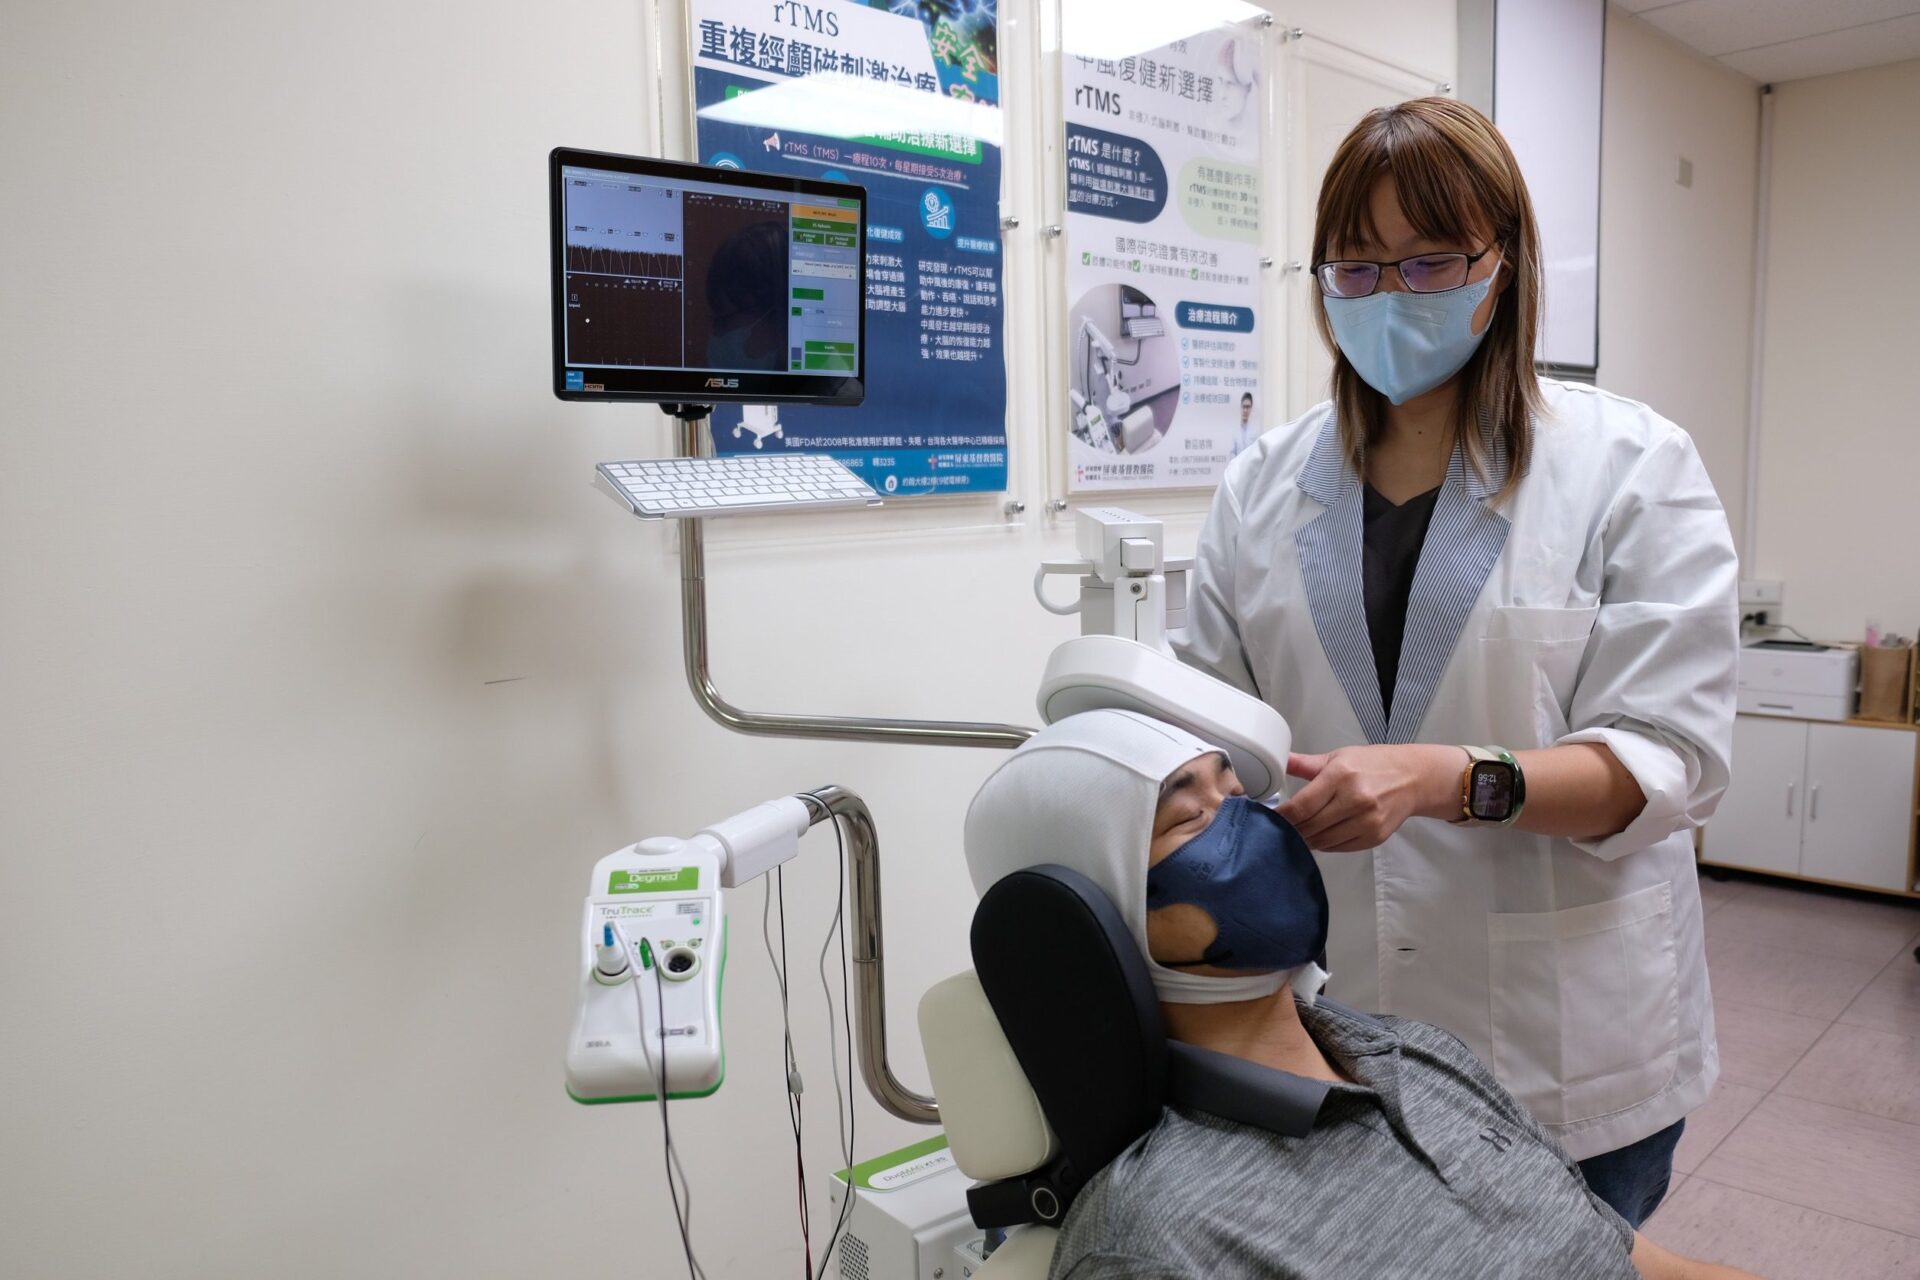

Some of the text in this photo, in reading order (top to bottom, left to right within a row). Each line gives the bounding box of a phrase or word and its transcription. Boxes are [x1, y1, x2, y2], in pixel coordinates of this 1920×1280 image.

[774, 1, 839, 37] rTMS
[1075, 84, 1121, 117] rTMS
[784, 142, 808, 155] rTMS
[1068, 135, 1099, 156] rTMS
[865, 299, 906, 313] 助調整大腦
[705, 378, 739, 388] ASUS
